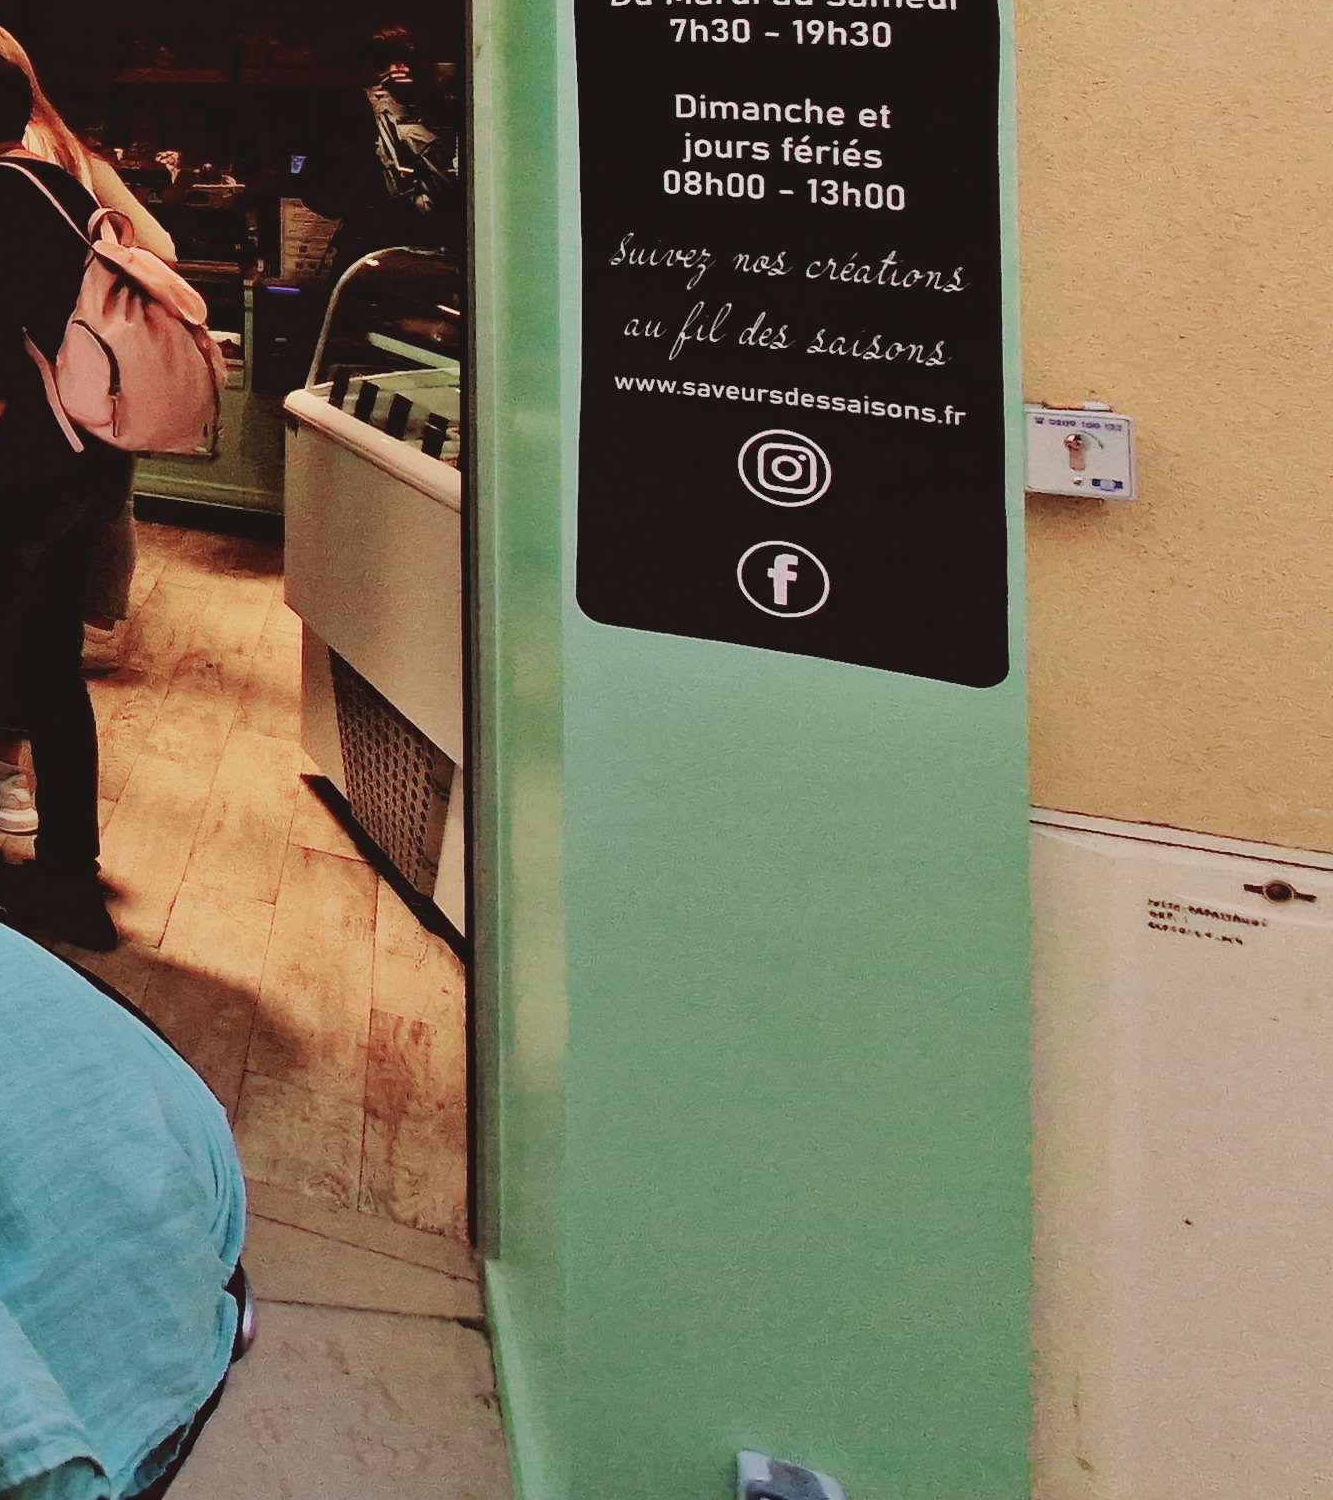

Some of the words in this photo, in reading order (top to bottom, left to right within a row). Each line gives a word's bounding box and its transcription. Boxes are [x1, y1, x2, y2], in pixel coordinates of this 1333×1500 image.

[669, 19, 751, 44] 7h30
[792, 19, 891, 48] 19h30
[674, 94, 845, 126] Dimanche
[858, 104, 891, 129] et
[682, 132, 770, 163] jours
[780, 135, 883, 168] fériés
[662, 170, 765, 199] 08h00
[807, 179, 905, 211] 13h00
[609, 232, 716, 290] Suivez
[733, 250, 793, 276] nos
[806, 250, 971, 293] créations
[624, 317, 667, 339] au
[669, 301, 732, 360] fil
[739, 312, 795, 350] des
[806, 328, 952, 367] saisons
[614, 375, 966, 426] www.saveursdessaisons.fr
